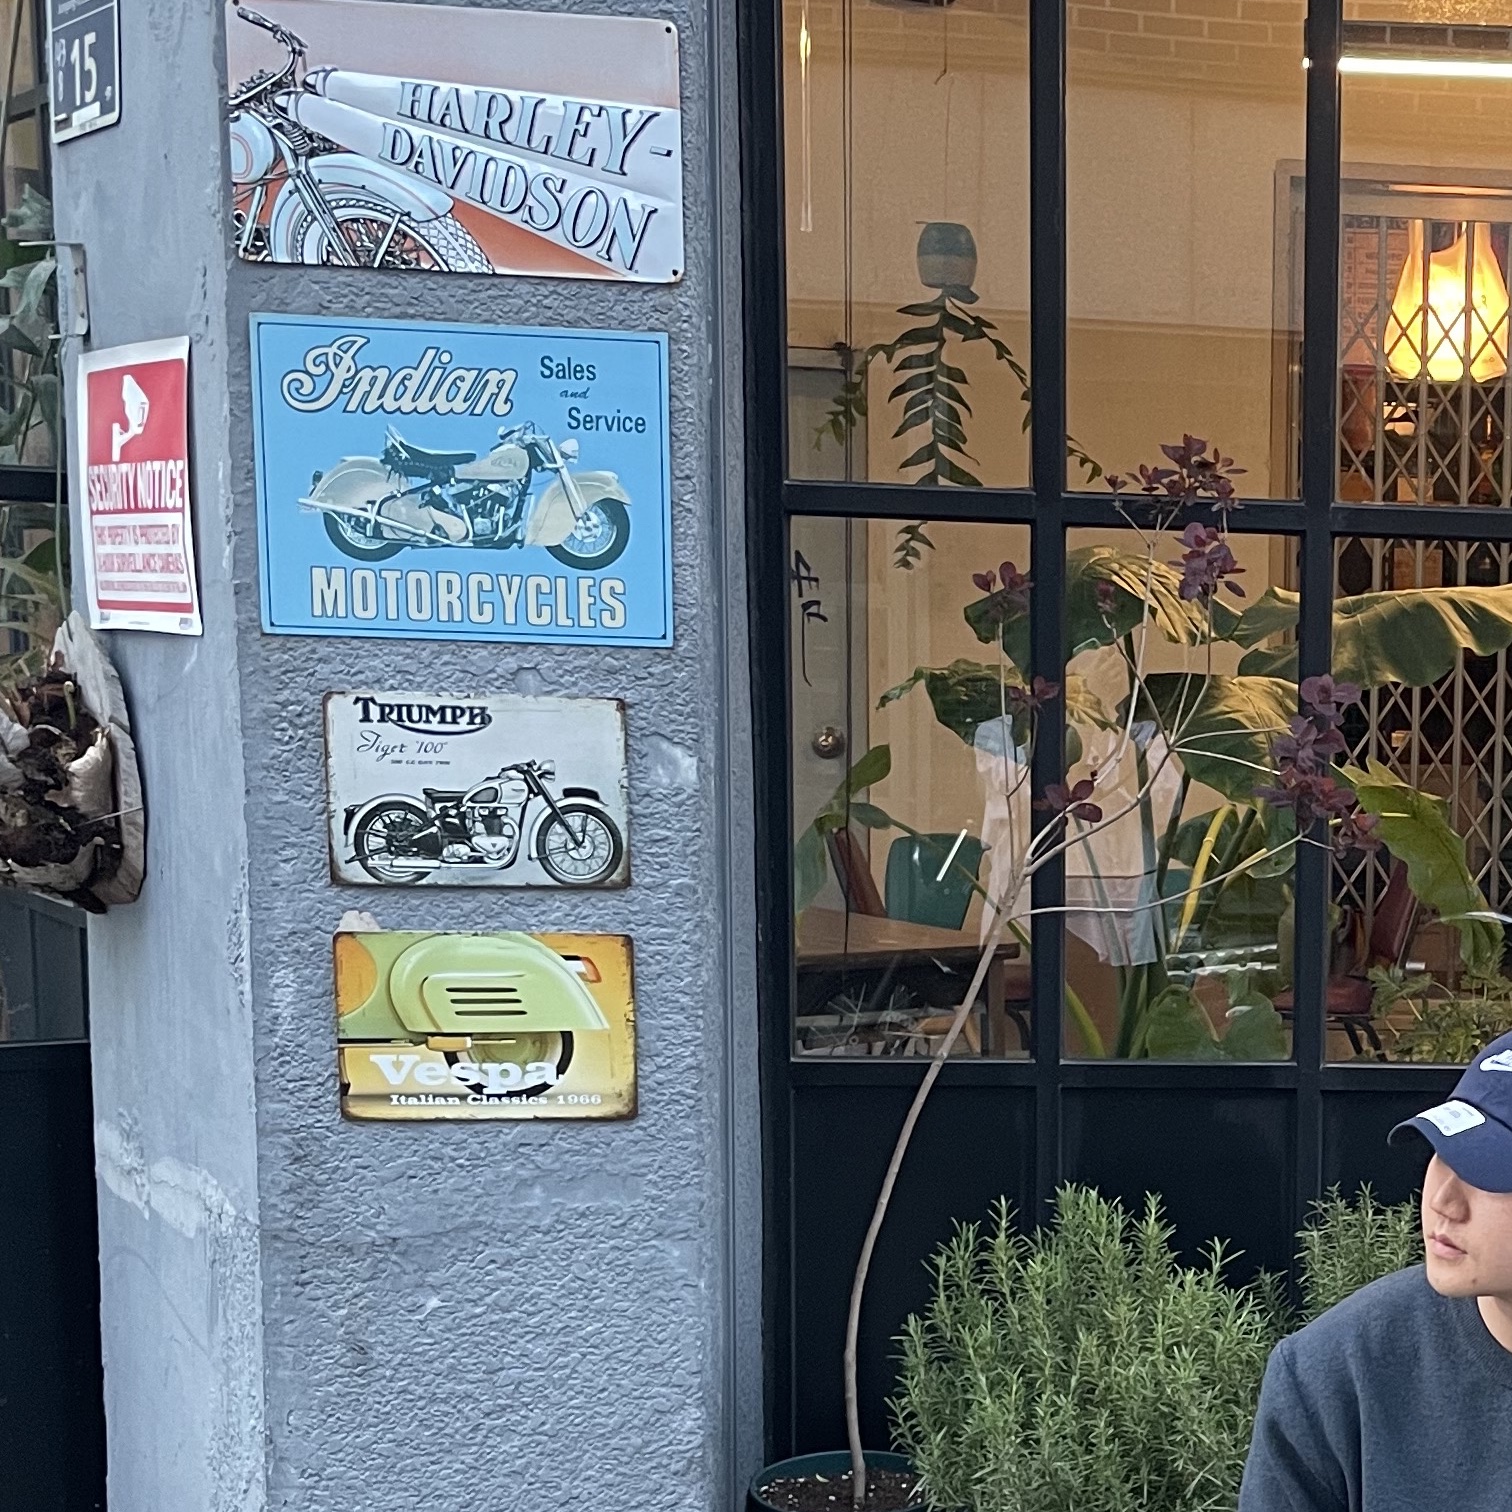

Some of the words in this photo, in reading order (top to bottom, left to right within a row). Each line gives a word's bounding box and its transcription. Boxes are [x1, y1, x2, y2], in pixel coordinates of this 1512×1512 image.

[70, 31, 98, 107] 15
[397, 80, 674, 176] HARLEY-
[379, 121, 659, 271] DAVIDSON
[281, 334, 518, 416] Indian
[539, 354, 597, 381] Sales
[559, 386, 590, 400] and
[567, 406, 647, 434] Service
[88, 461, 136, 511] SECURITY
[137, 459, 184, 510] NOTICE
[310, 564, 628, 630] MOTORCYCLES
[352, 695, 494, 730] TRIUMPH
[356, 729, 408, 763] Tiger
[369, 1054, 565, 1095] Vespa
[390, 1095, 461, 1106] Italian
[467, 1094, 548, 1106] Classics
[557, 1095, 602, 1106] 1966
